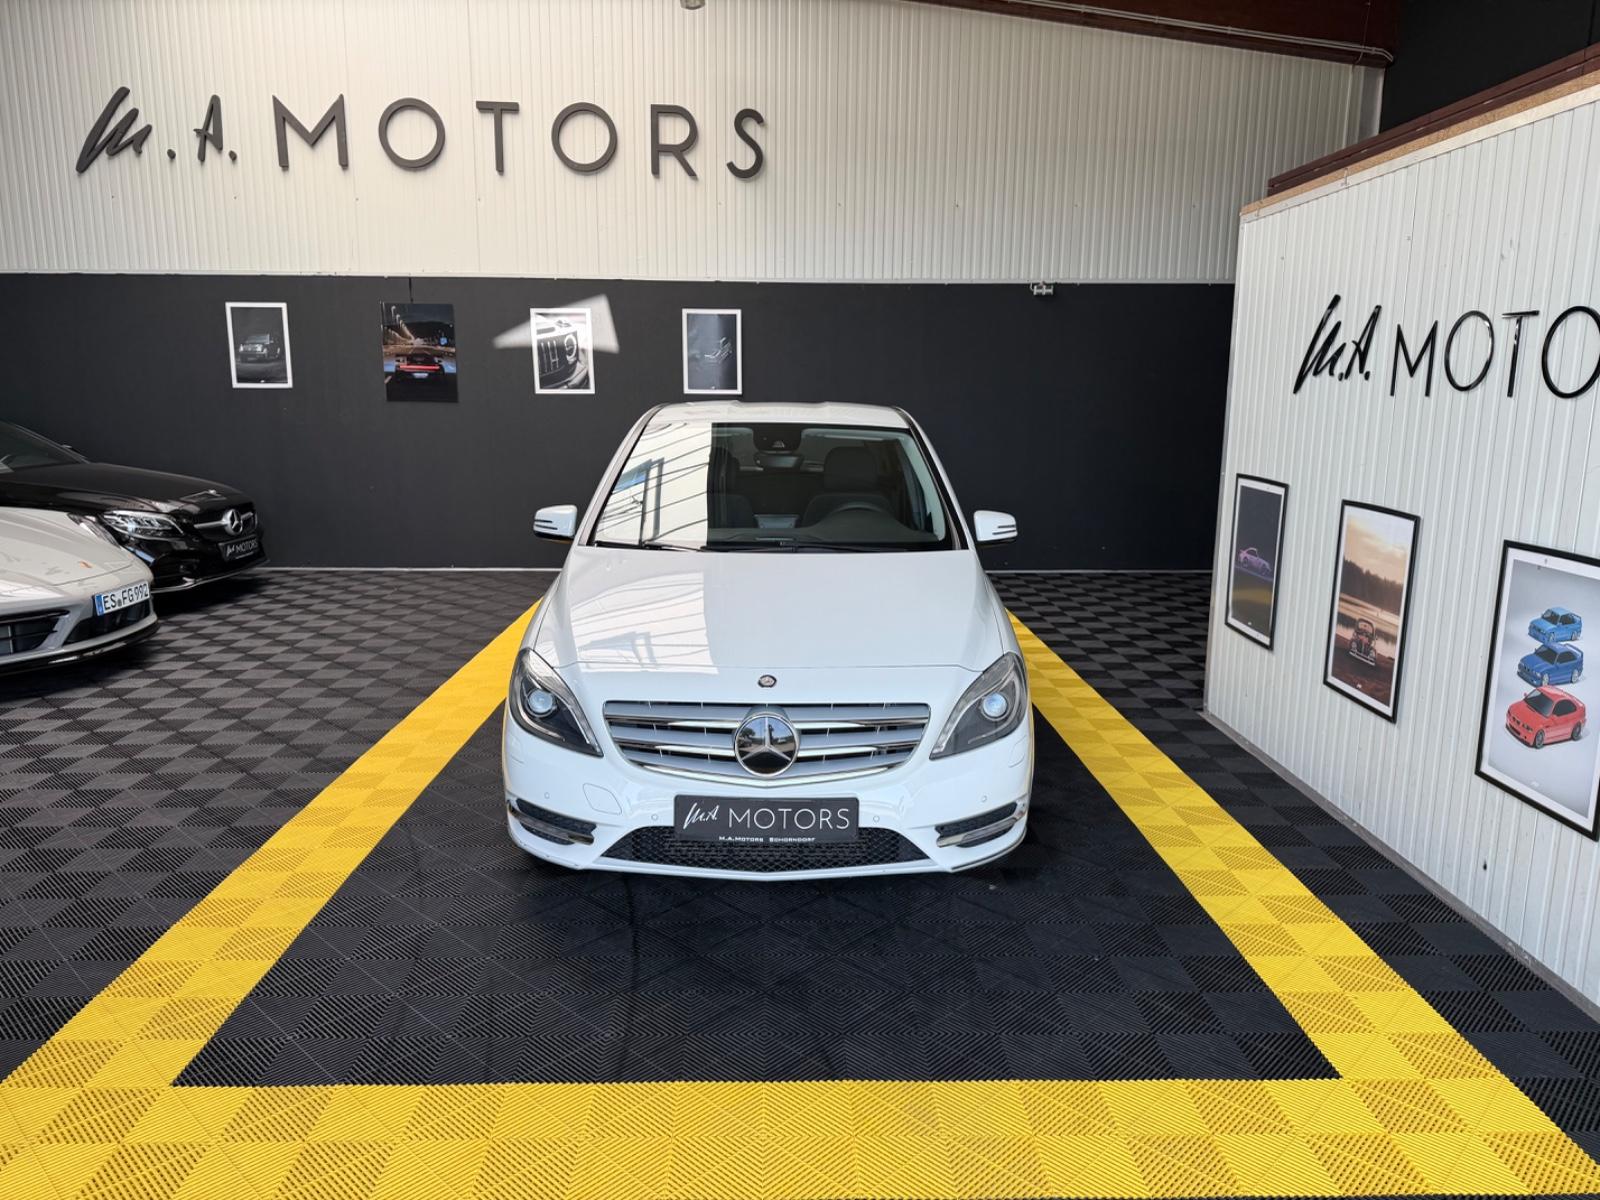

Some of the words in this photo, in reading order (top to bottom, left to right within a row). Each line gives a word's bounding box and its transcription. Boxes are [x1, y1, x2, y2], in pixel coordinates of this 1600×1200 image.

[272, 94, 766, 182] MOTORS
[235, 539, 258, 553] MOTORS
[103, 593, 117, 611] ES
[133, 583, 149, 601] 992
[728, 808, 850, 830] MOTORS
